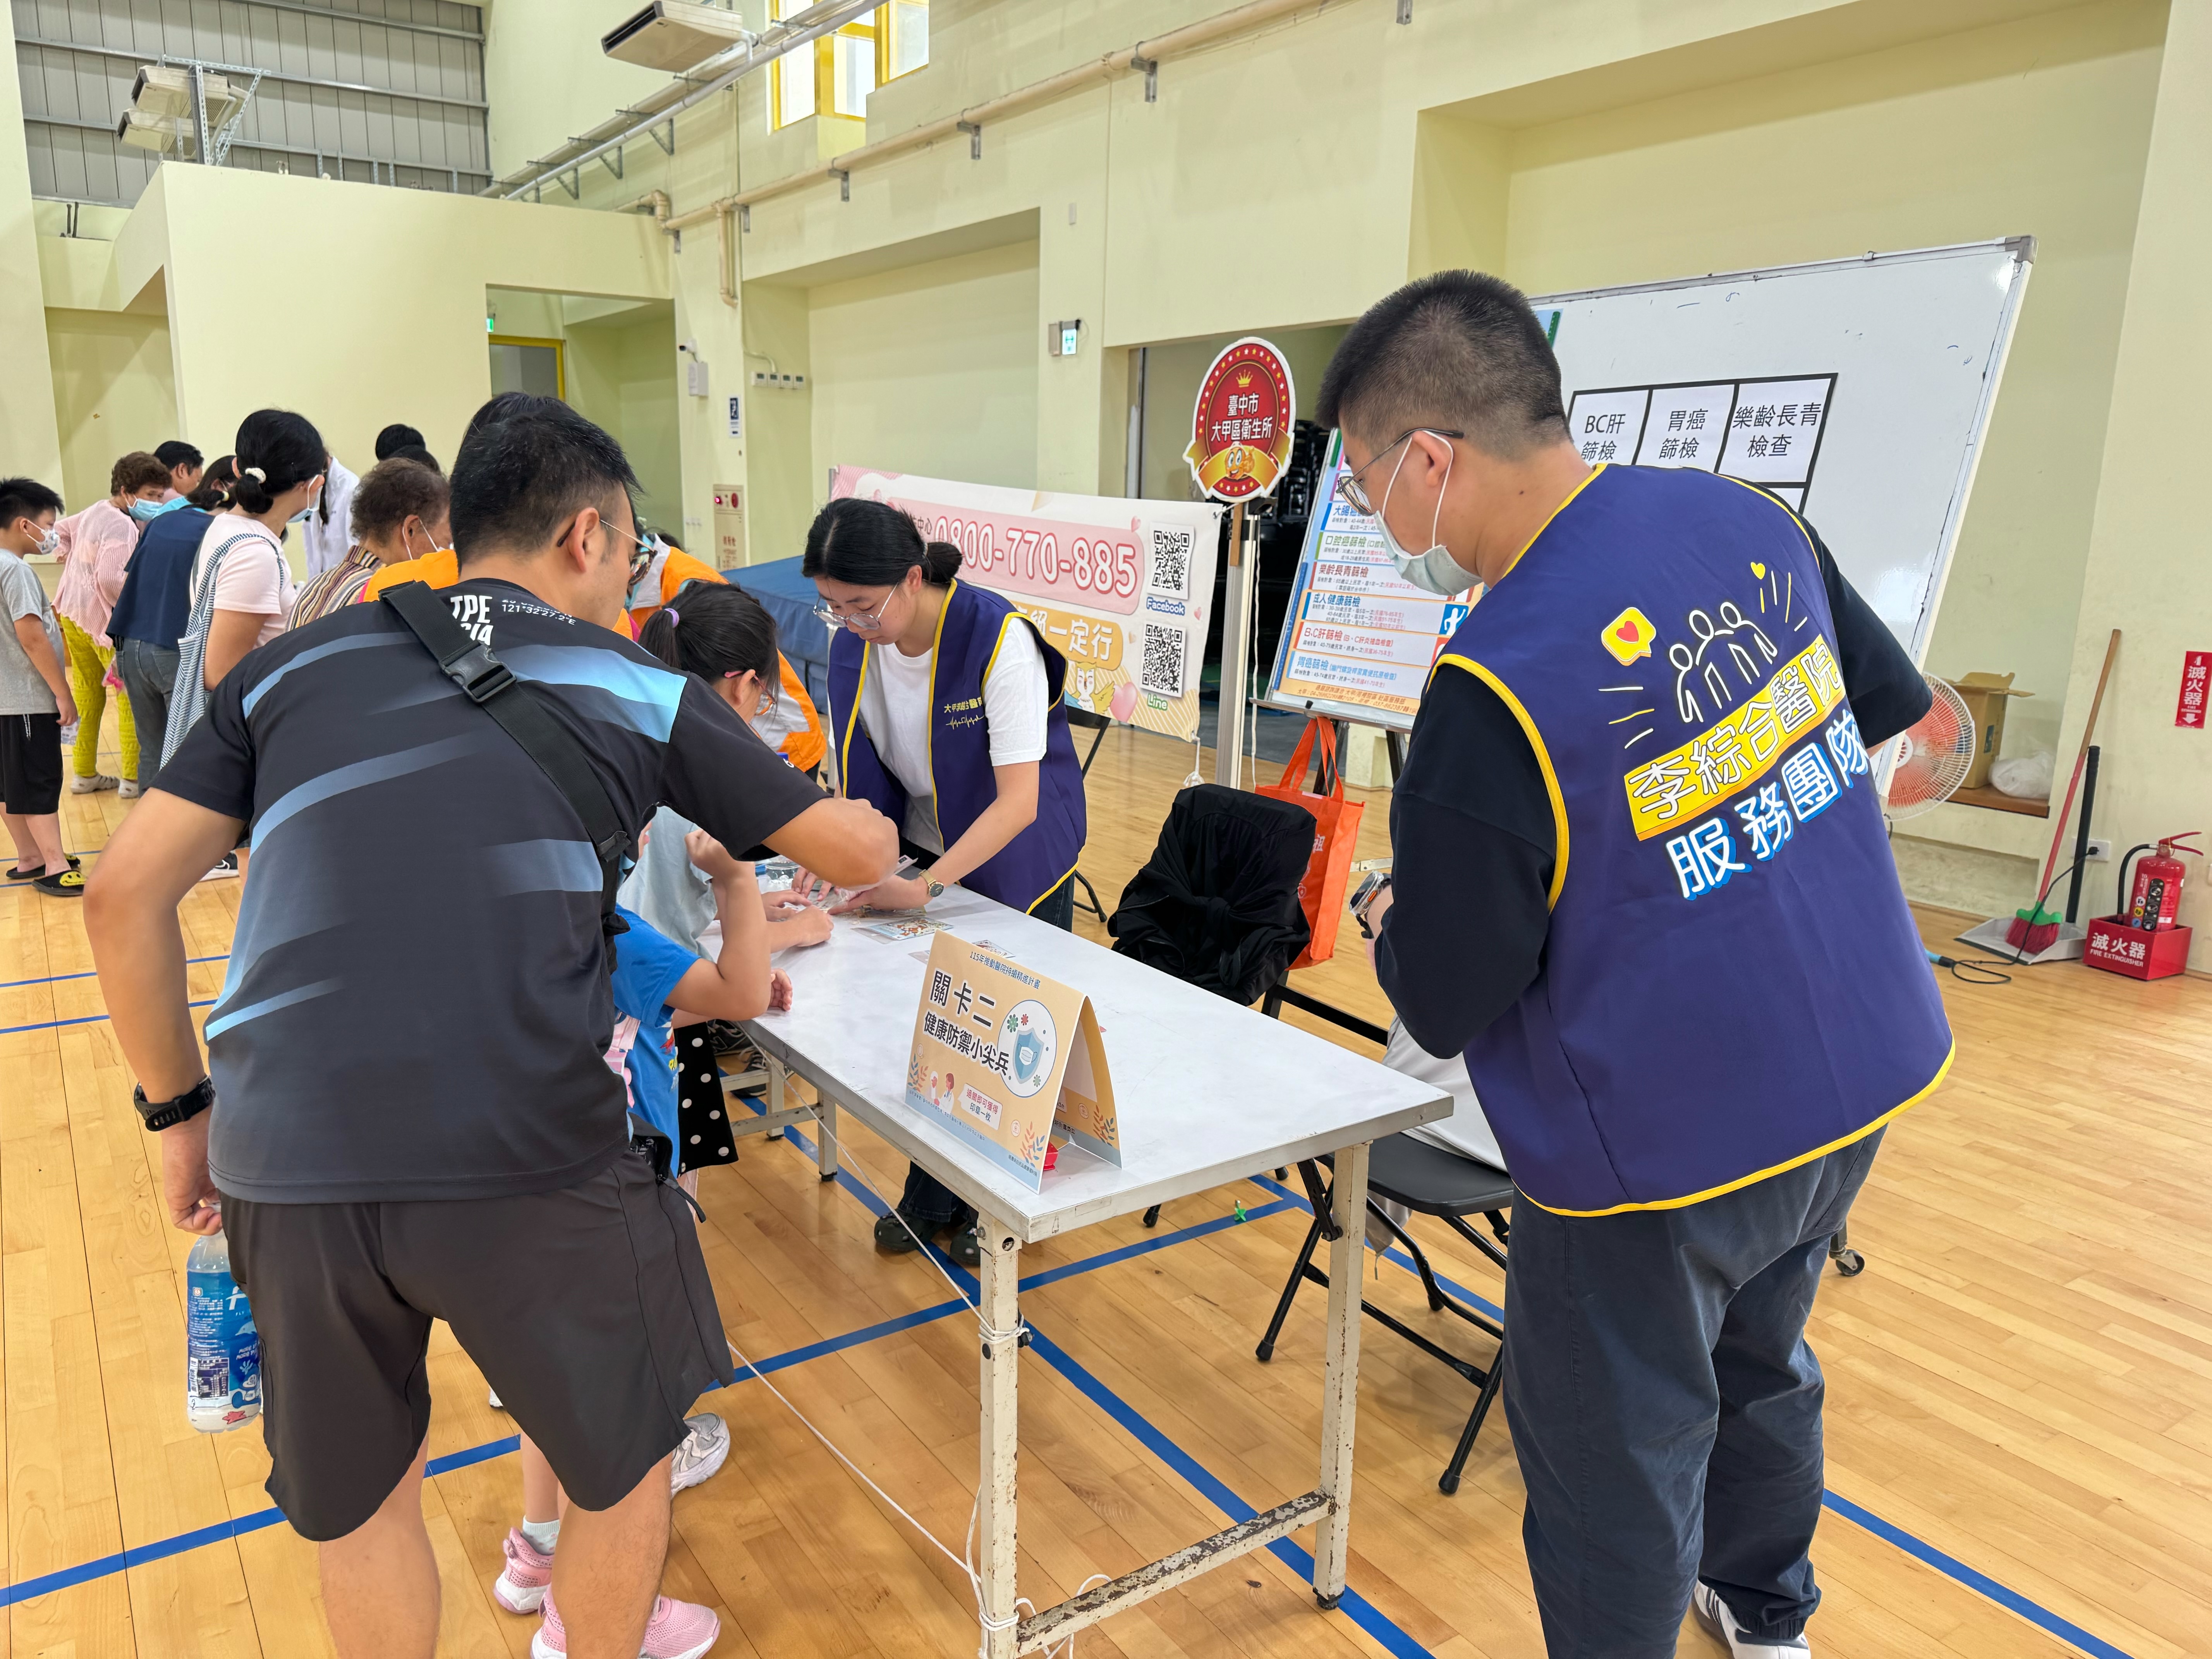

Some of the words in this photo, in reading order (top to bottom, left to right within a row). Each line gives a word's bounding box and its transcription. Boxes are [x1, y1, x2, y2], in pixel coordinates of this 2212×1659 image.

[1227, 393, 1259, 416] 臺中市
[1733, 403, 1821, 429] 樂齡長青
[1211, 416, 1273, 442] 大甲區衛生所
[1585, 413, 1626, 434] BC肝
[1668, 408, 1708, 431] 胃癌
[1581, 440, 1617, 461] 篩檢
[1659, 437, 1700, 459] 篩檢
[1747, 434, 1792, 458] 檢查
[1325, 536, 1367, 548] 口腔癌篩檢
[934, 516, 1137, 598] 0800-770-885
[1319, 563, 1369, 578] 樂齡長青篩檢
[450, 595, 493, 623] TPE
[1147, 597, 1185, 616] Facebook
[1313, 592, 1361, 608] 成人健康篩檢
[1297, 656, 1329, 671] 胃癌篩檢
[2184, 666, 2207, 706] 滅火器
[1147, 693, 1168, 711] Line
[1629, 643, 1843, 819] 李綜合醫院
[1666, 710, 1868, 900] 服務團隊
[2090, 949, 2102, 957] FIRE
[2104, 952, 2144, 967] EXTINGUISHER
[2092, 933, 2146, 960] 滅火器
[930, 970, 995, 1028] 關卡二
[924, 1011, 1010, 1076] 健康防禦小尖兵
[966, 1089, 998, 1115] 過關即可獲得
[970, 1103, 991, 1122] 印章一枚
